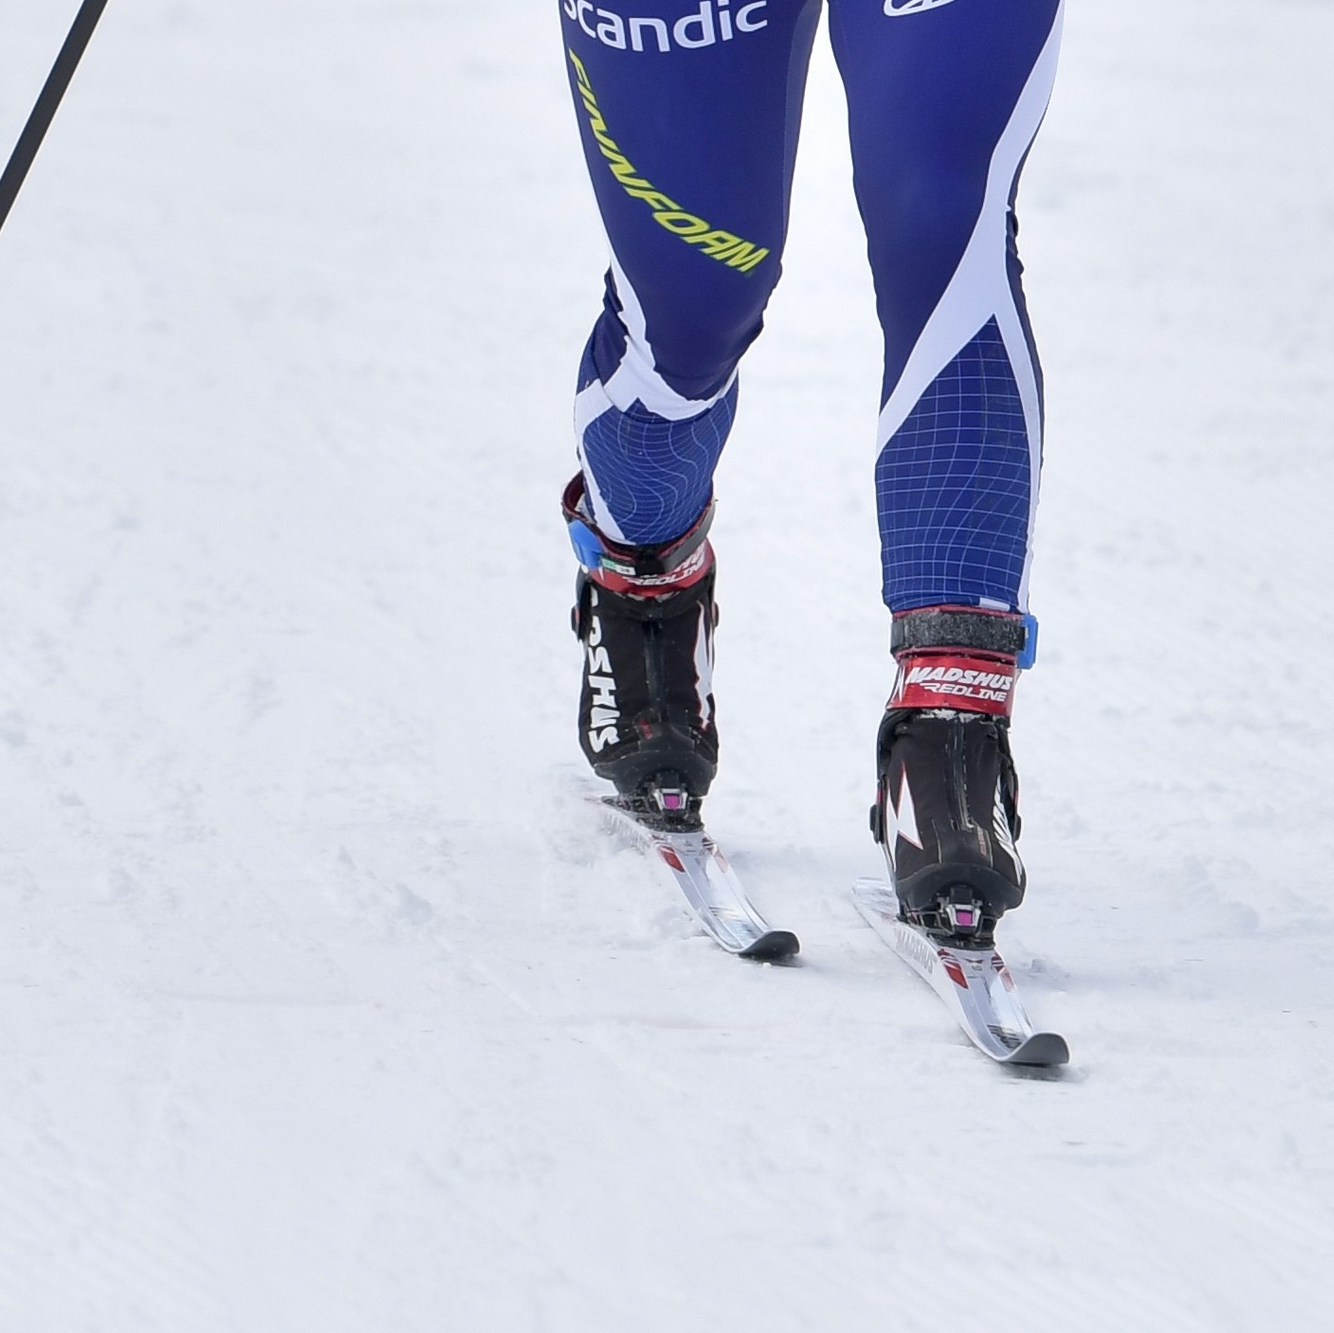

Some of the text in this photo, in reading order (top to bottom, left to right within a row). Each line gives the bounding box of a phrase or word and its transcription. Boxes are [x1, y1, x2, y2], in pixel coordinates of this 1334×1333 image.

[568, 47, 770, 273] FINNFOAM
[905, 666, 1014, 691] MADSHUS
[919, 682, 1009, 703] REDLINE
